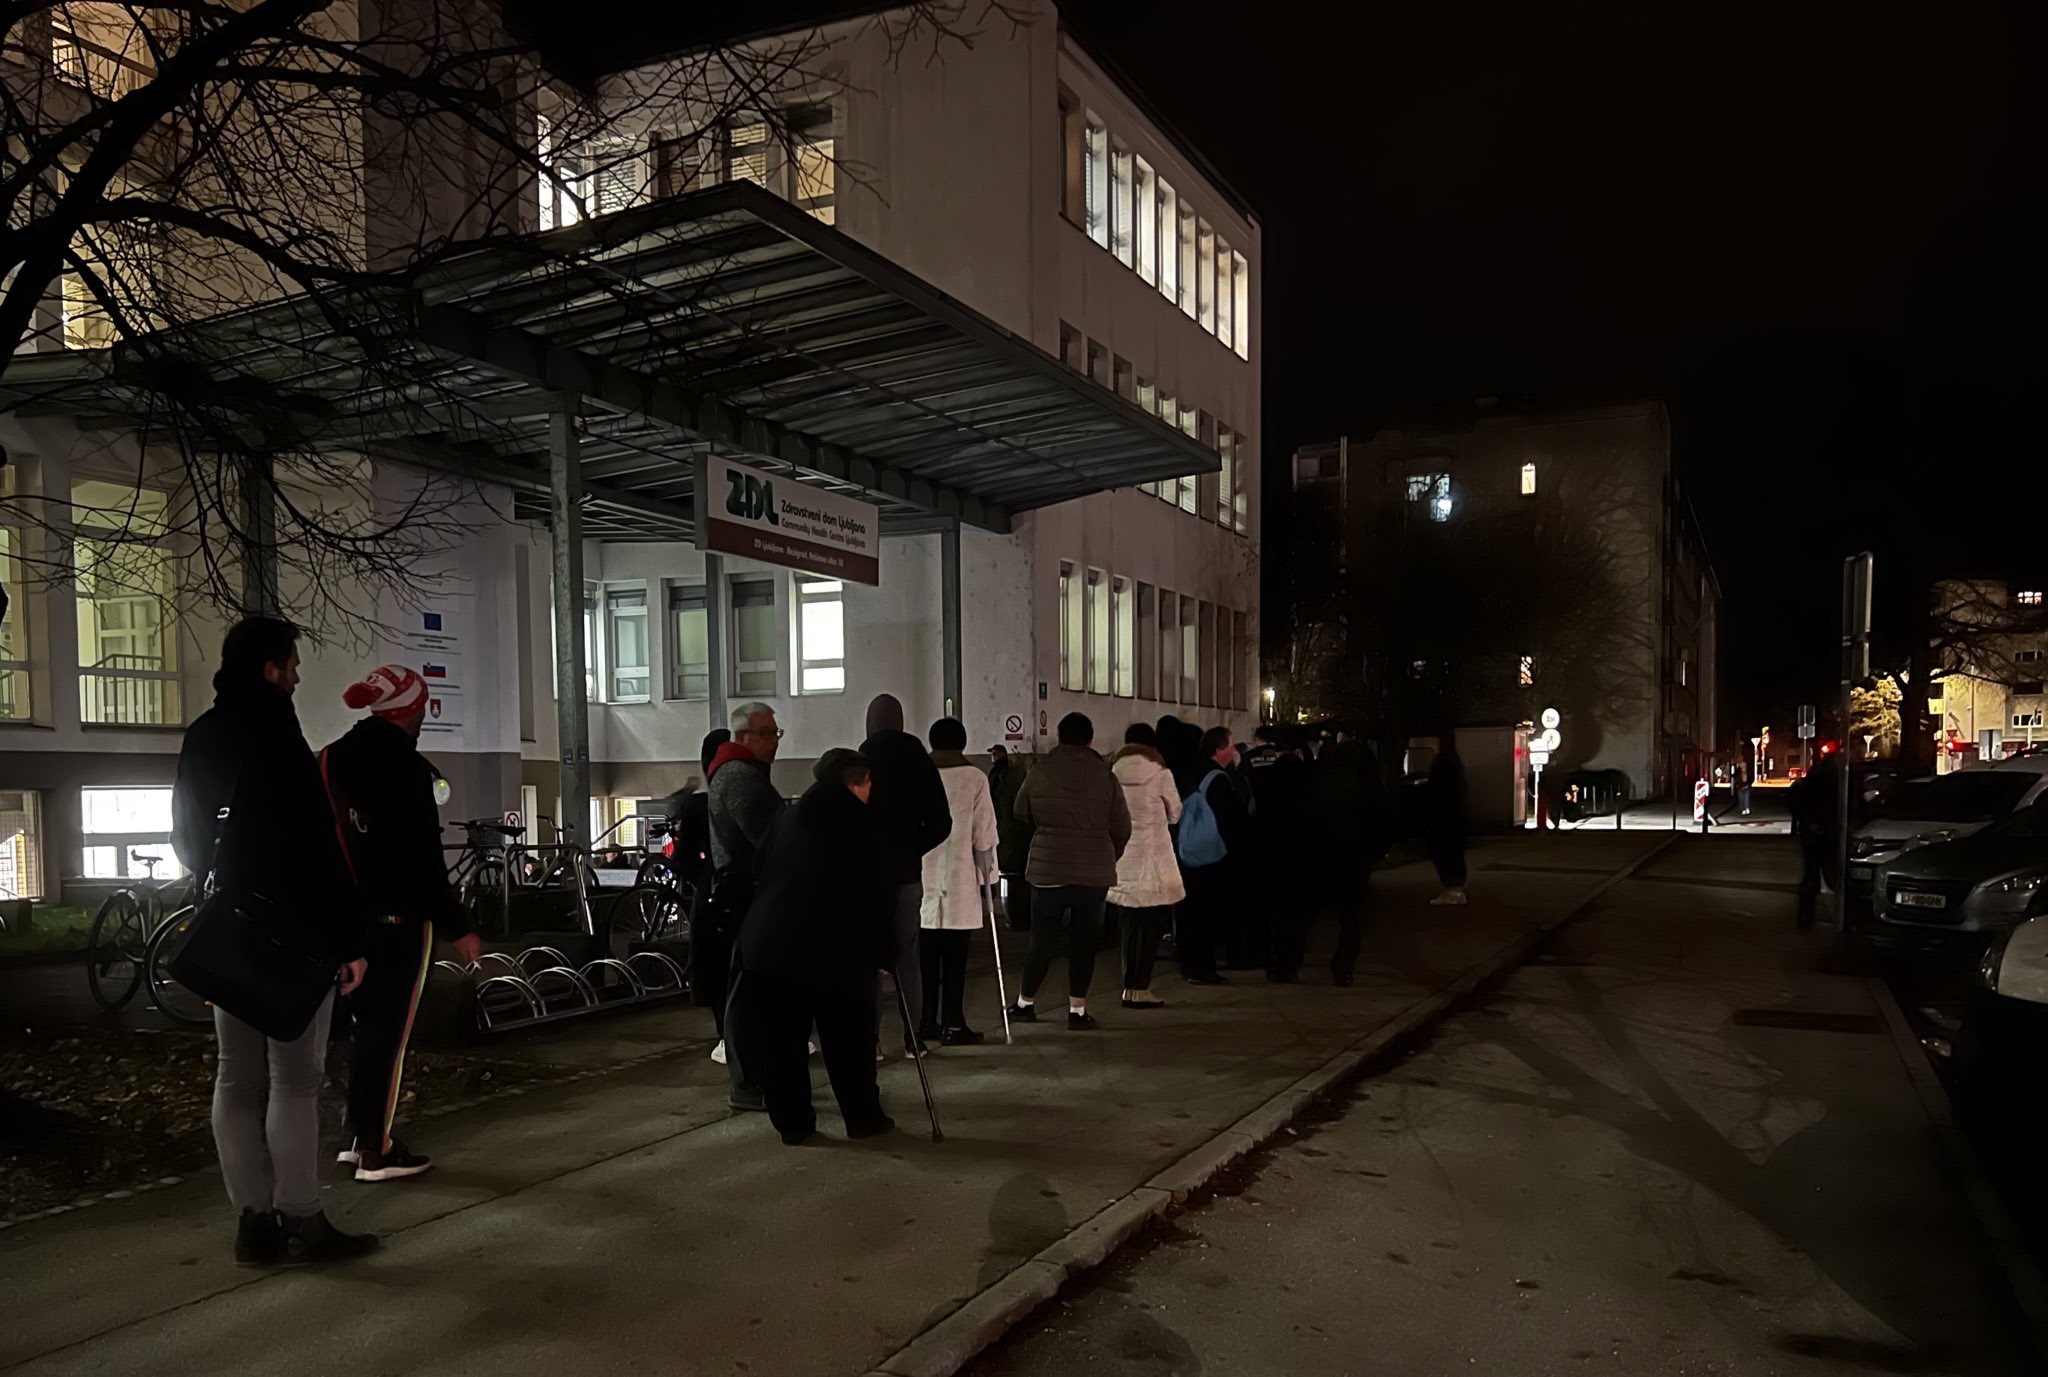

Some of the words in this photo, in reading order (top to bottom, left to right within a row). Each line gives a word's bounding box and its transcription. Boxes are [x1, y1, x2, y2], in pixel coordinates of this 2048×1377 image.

[727, 469, 779, 526] ZDL
[781, 499, 821, 522] Zdravstveni
[822, 512, 837, 526] dom
[838, 516, 866, 534] Ljubljana
[781, 518, 810, 536] Community
[812, 526, 828, 538] Health
[829, 530, 844, 542] Centre
[845, 535, 866, 548] Ljubljana
